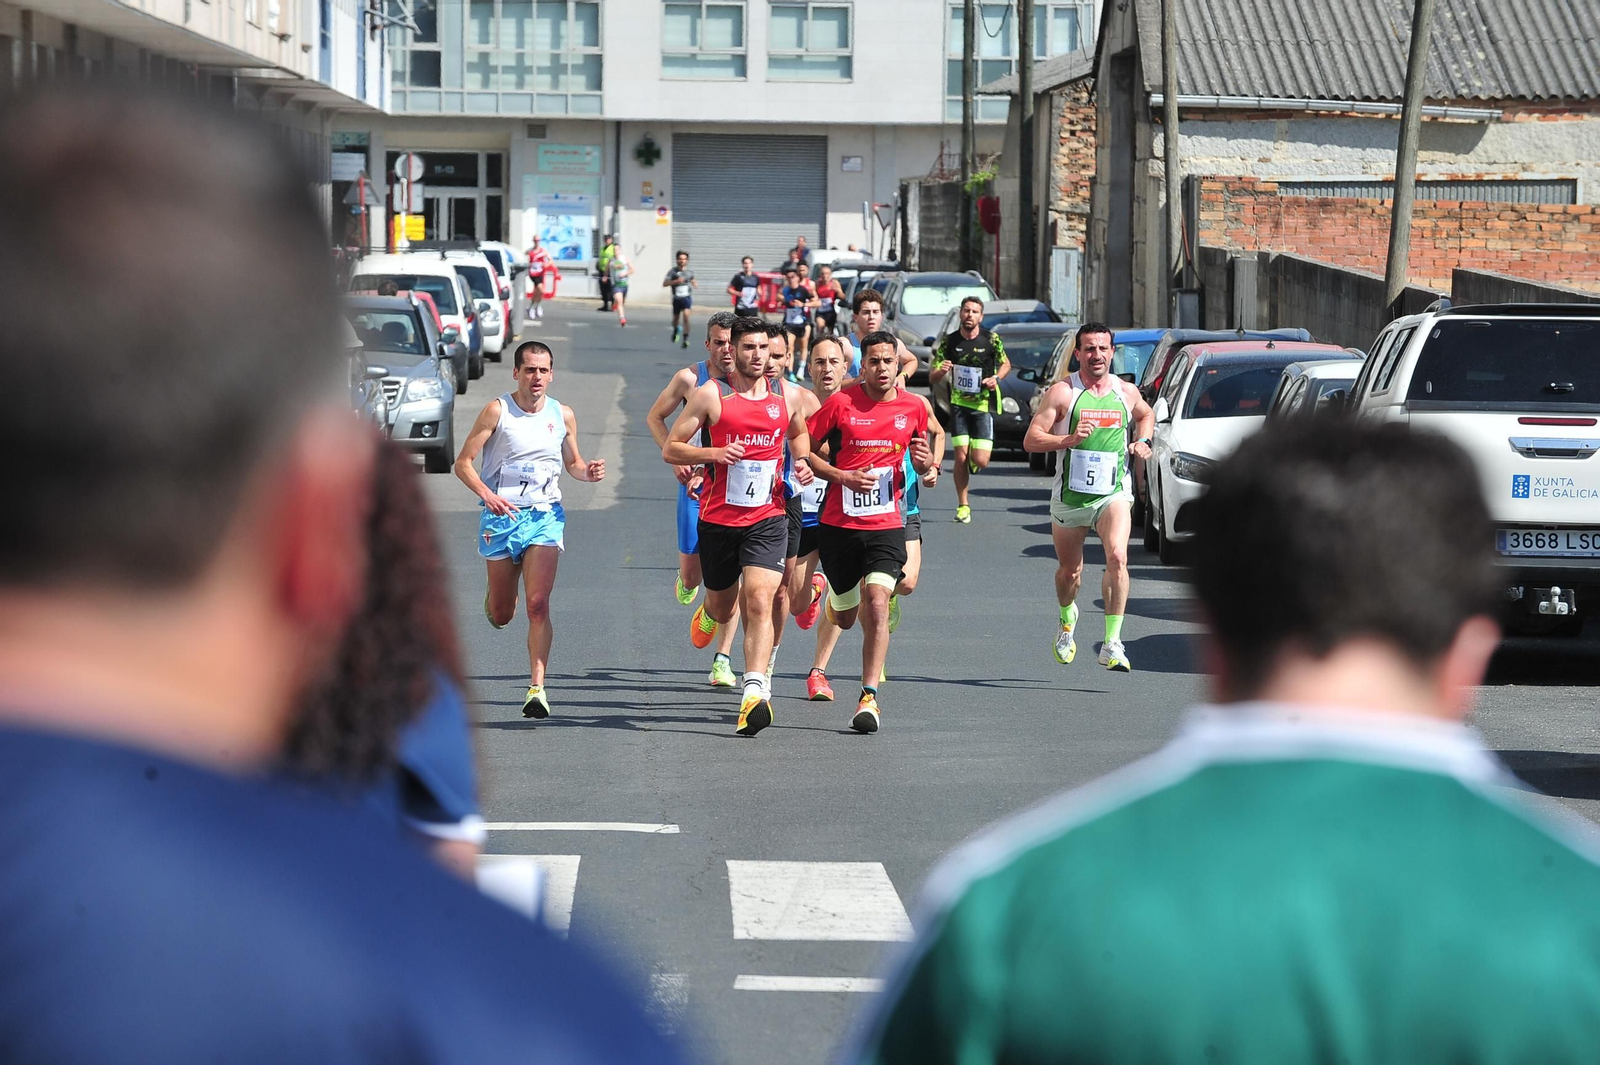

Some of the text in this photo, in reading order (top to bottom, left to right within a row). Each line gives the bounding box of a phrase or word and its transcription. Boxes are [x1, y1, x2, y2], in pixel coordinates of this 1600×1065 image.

[957, 376, 973, 388] 206
[1082, 411, 1121, 419] mandarina
[744, 433, 775, 446] GANGA
[1086, 470, 1095, 486] 5
[1534, 477, 1574, 487] XUNTA
[520, 481, 529, 497] 7
[745, 481, 755, 499] 4
[1533, 488, 1599, 498] DE GALICIA
[1510, 532, 1559, 549] 3668
